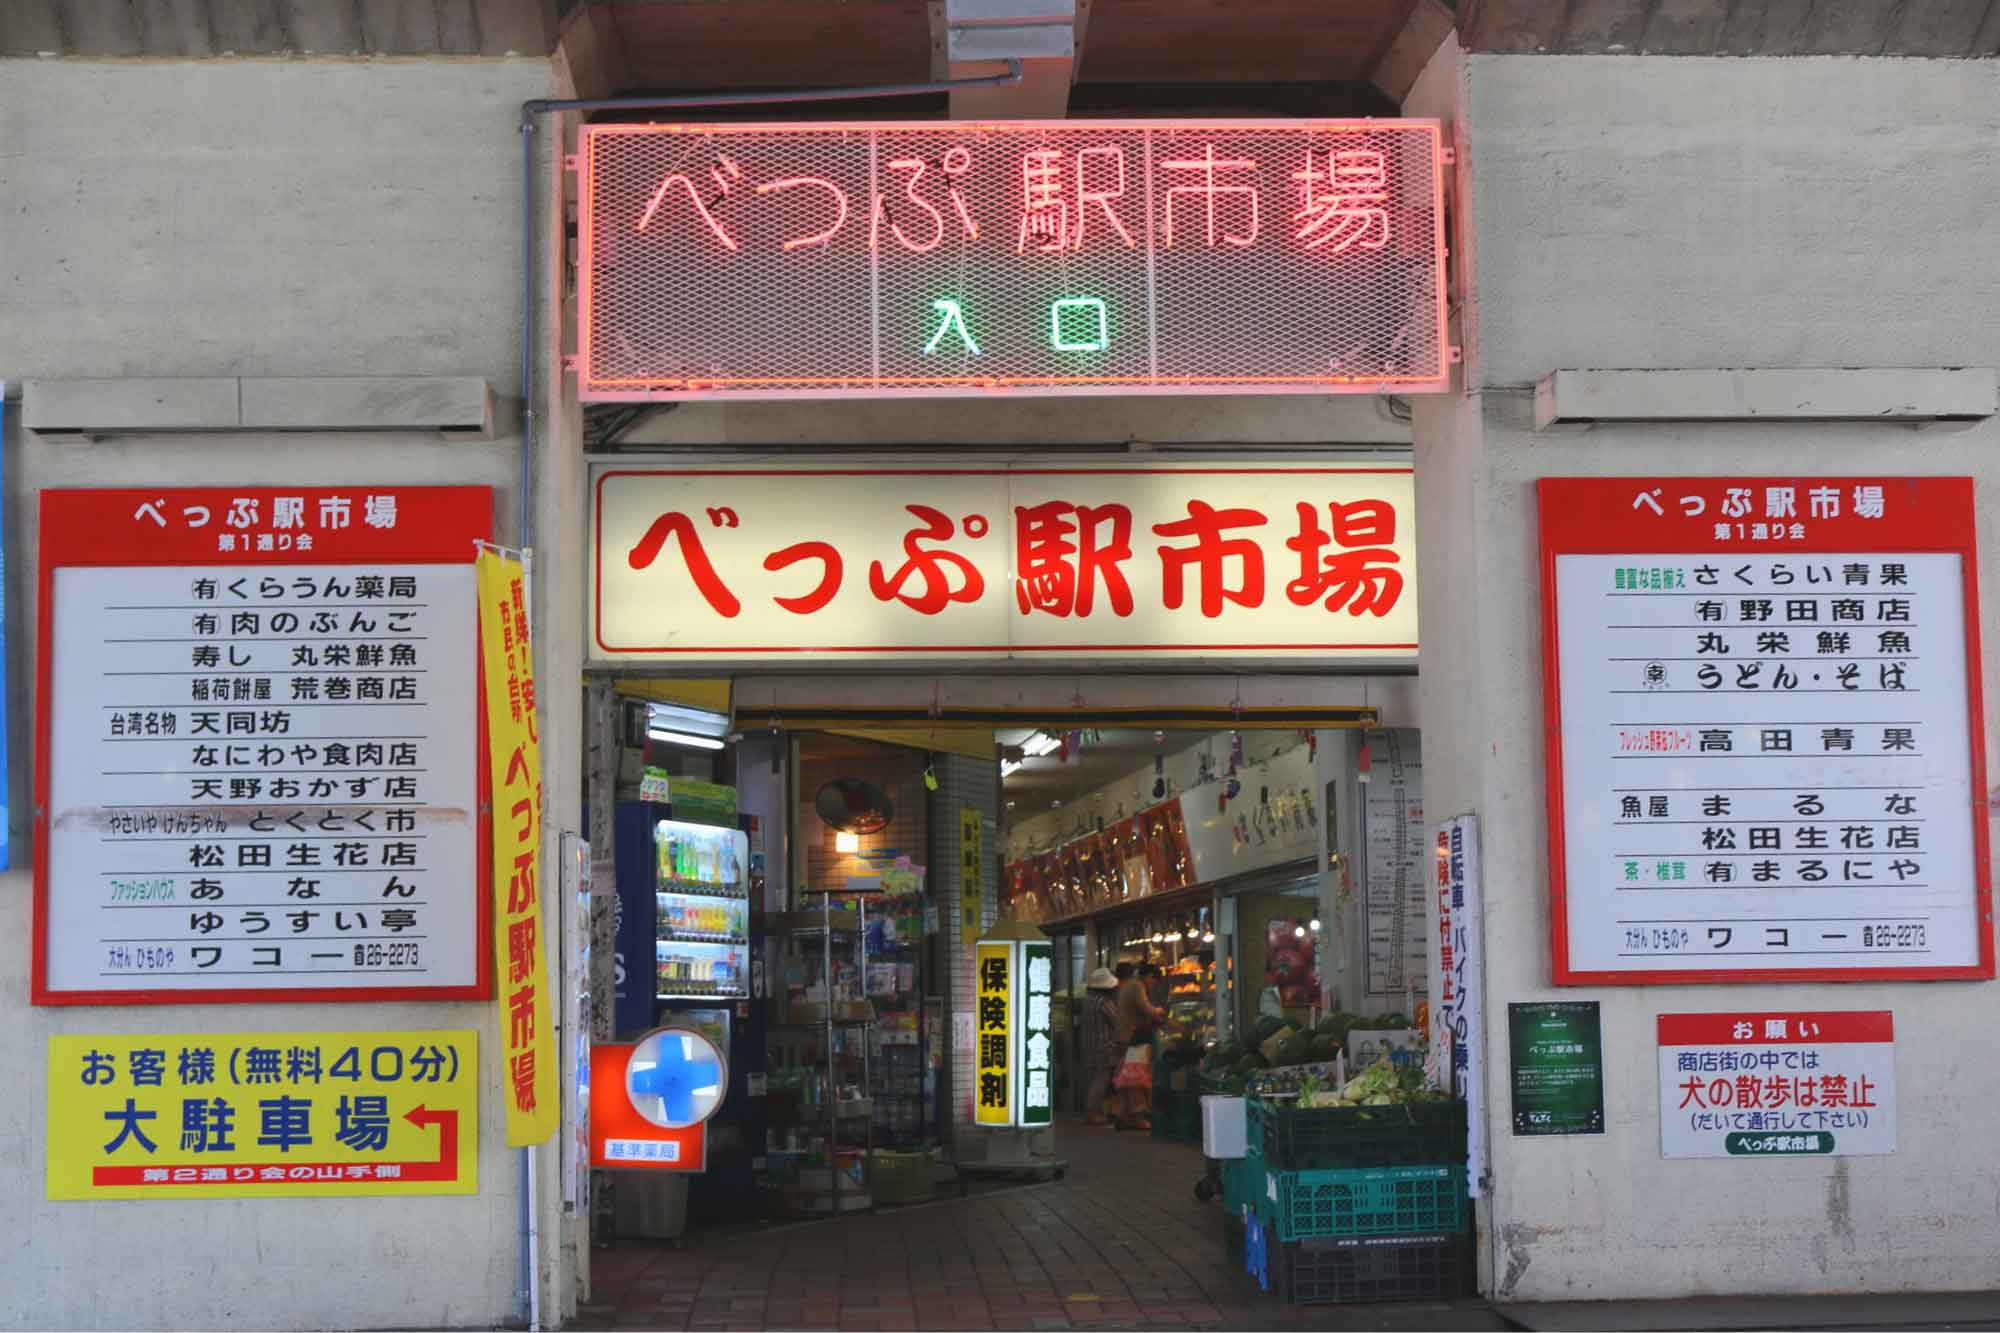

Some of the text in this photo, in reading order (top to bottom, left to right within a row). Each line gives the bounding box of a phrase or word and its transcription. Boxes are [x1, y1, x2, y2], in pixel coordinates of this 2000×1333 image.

[637, 143, 1391, 255] べっぷ駅市場
[924, 297, 1109, 356] 入口
[134, 495, 398, 530] べっぷ駅市場
[1632, 486, 1886, 520] べっぷ駅市場
[217, 533, 313, 552] 第1通り会
[1714, 523, 1805, 541] 第1通り会
[628, 499, 1403, 619] べっぷ駅市場
[1615, 563, 1908, 590] 豊富な品揃え さくらい青果
[1697, 631, 1911, 654] 丸栄鮮魚
[192, 643, 417, 668] 寿し 丸栄鮮魚
[291, 676, 417, 700] 荒巻商店
[1697, 660, 1907, 691] うどん・そば
[110, 711, 291, 736] 台湾名物 天同坊
[1699, 728, 1916, 752] 高田青果
[192, 743, 417, 767] なにわや食肉店
[191, 776, 417, 800] 天野おかず店
[1621, 793, 1918, 819] 魚屋 まるな
[249, 809, 416, 833] とくとく市
[1702, 826, 1921, 851] 松田生花店
[189, 842, 417, 868] 松田生花店
[110, 876, 416, 902] ファッションハウス あなん
[190, 908, 417, 933] ゆうすい亭
[1707, 928, 1848, 949] ワコー
[191, 947, 344, 969] ワコー
[979, 957, 1008, 1108] 保険調剤
[1733, 1020, 1821, 1041] お願い
[1678, 1051, 1819, 1072] 商店街の中では
[1679, 1074, 1876, 1110] 犬の散歩は禁止
[104, 1095, 390, 1154] 大駐車場
[1690, 1110, 1868, 1131] (だいて通行して下さい)
[143, 1164, 401, 1183] 第2通り会の山手側
